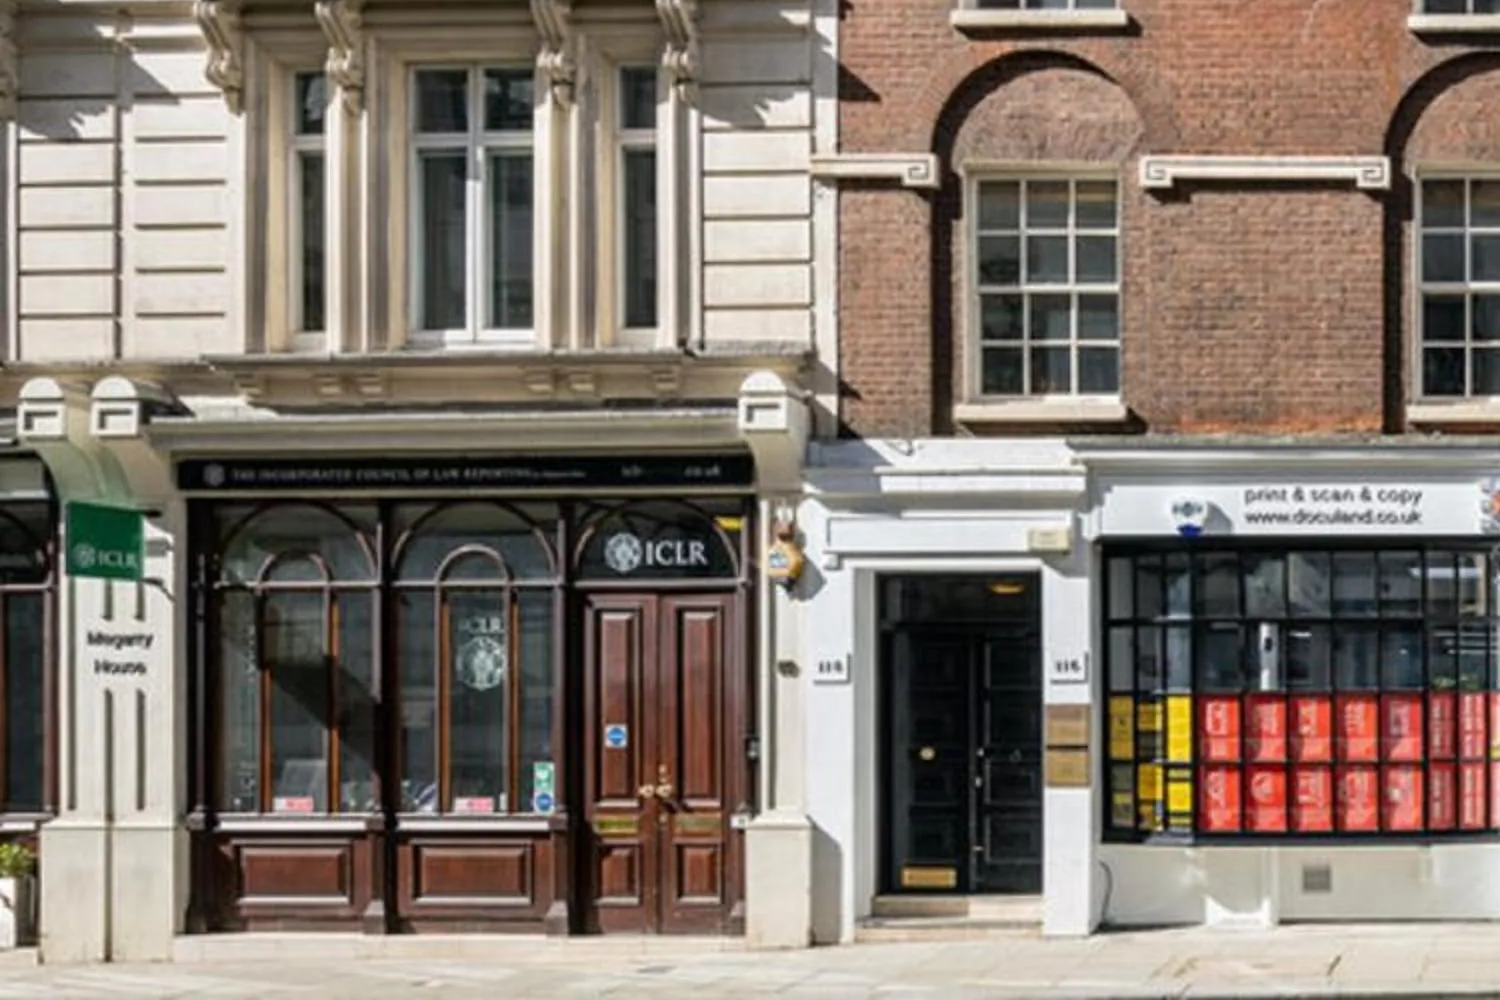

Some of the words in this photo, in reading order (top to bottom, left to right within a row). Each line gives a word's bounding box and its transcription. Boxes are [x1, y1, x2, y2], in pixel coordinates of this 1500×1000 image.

[1245, 487, 1287, 504] print
[1293, 486, 1304, 502] &
[1310, 488, 1354, 502] scan
[1360, 486, 1372, 502] &
[1377, 488, 1423, 505] copy
[1245, 507, 1422, 525] www.doculand.co.uk
[99, 551, 138, 569] ICLR
[645, 540, 708, 566] ICLR
